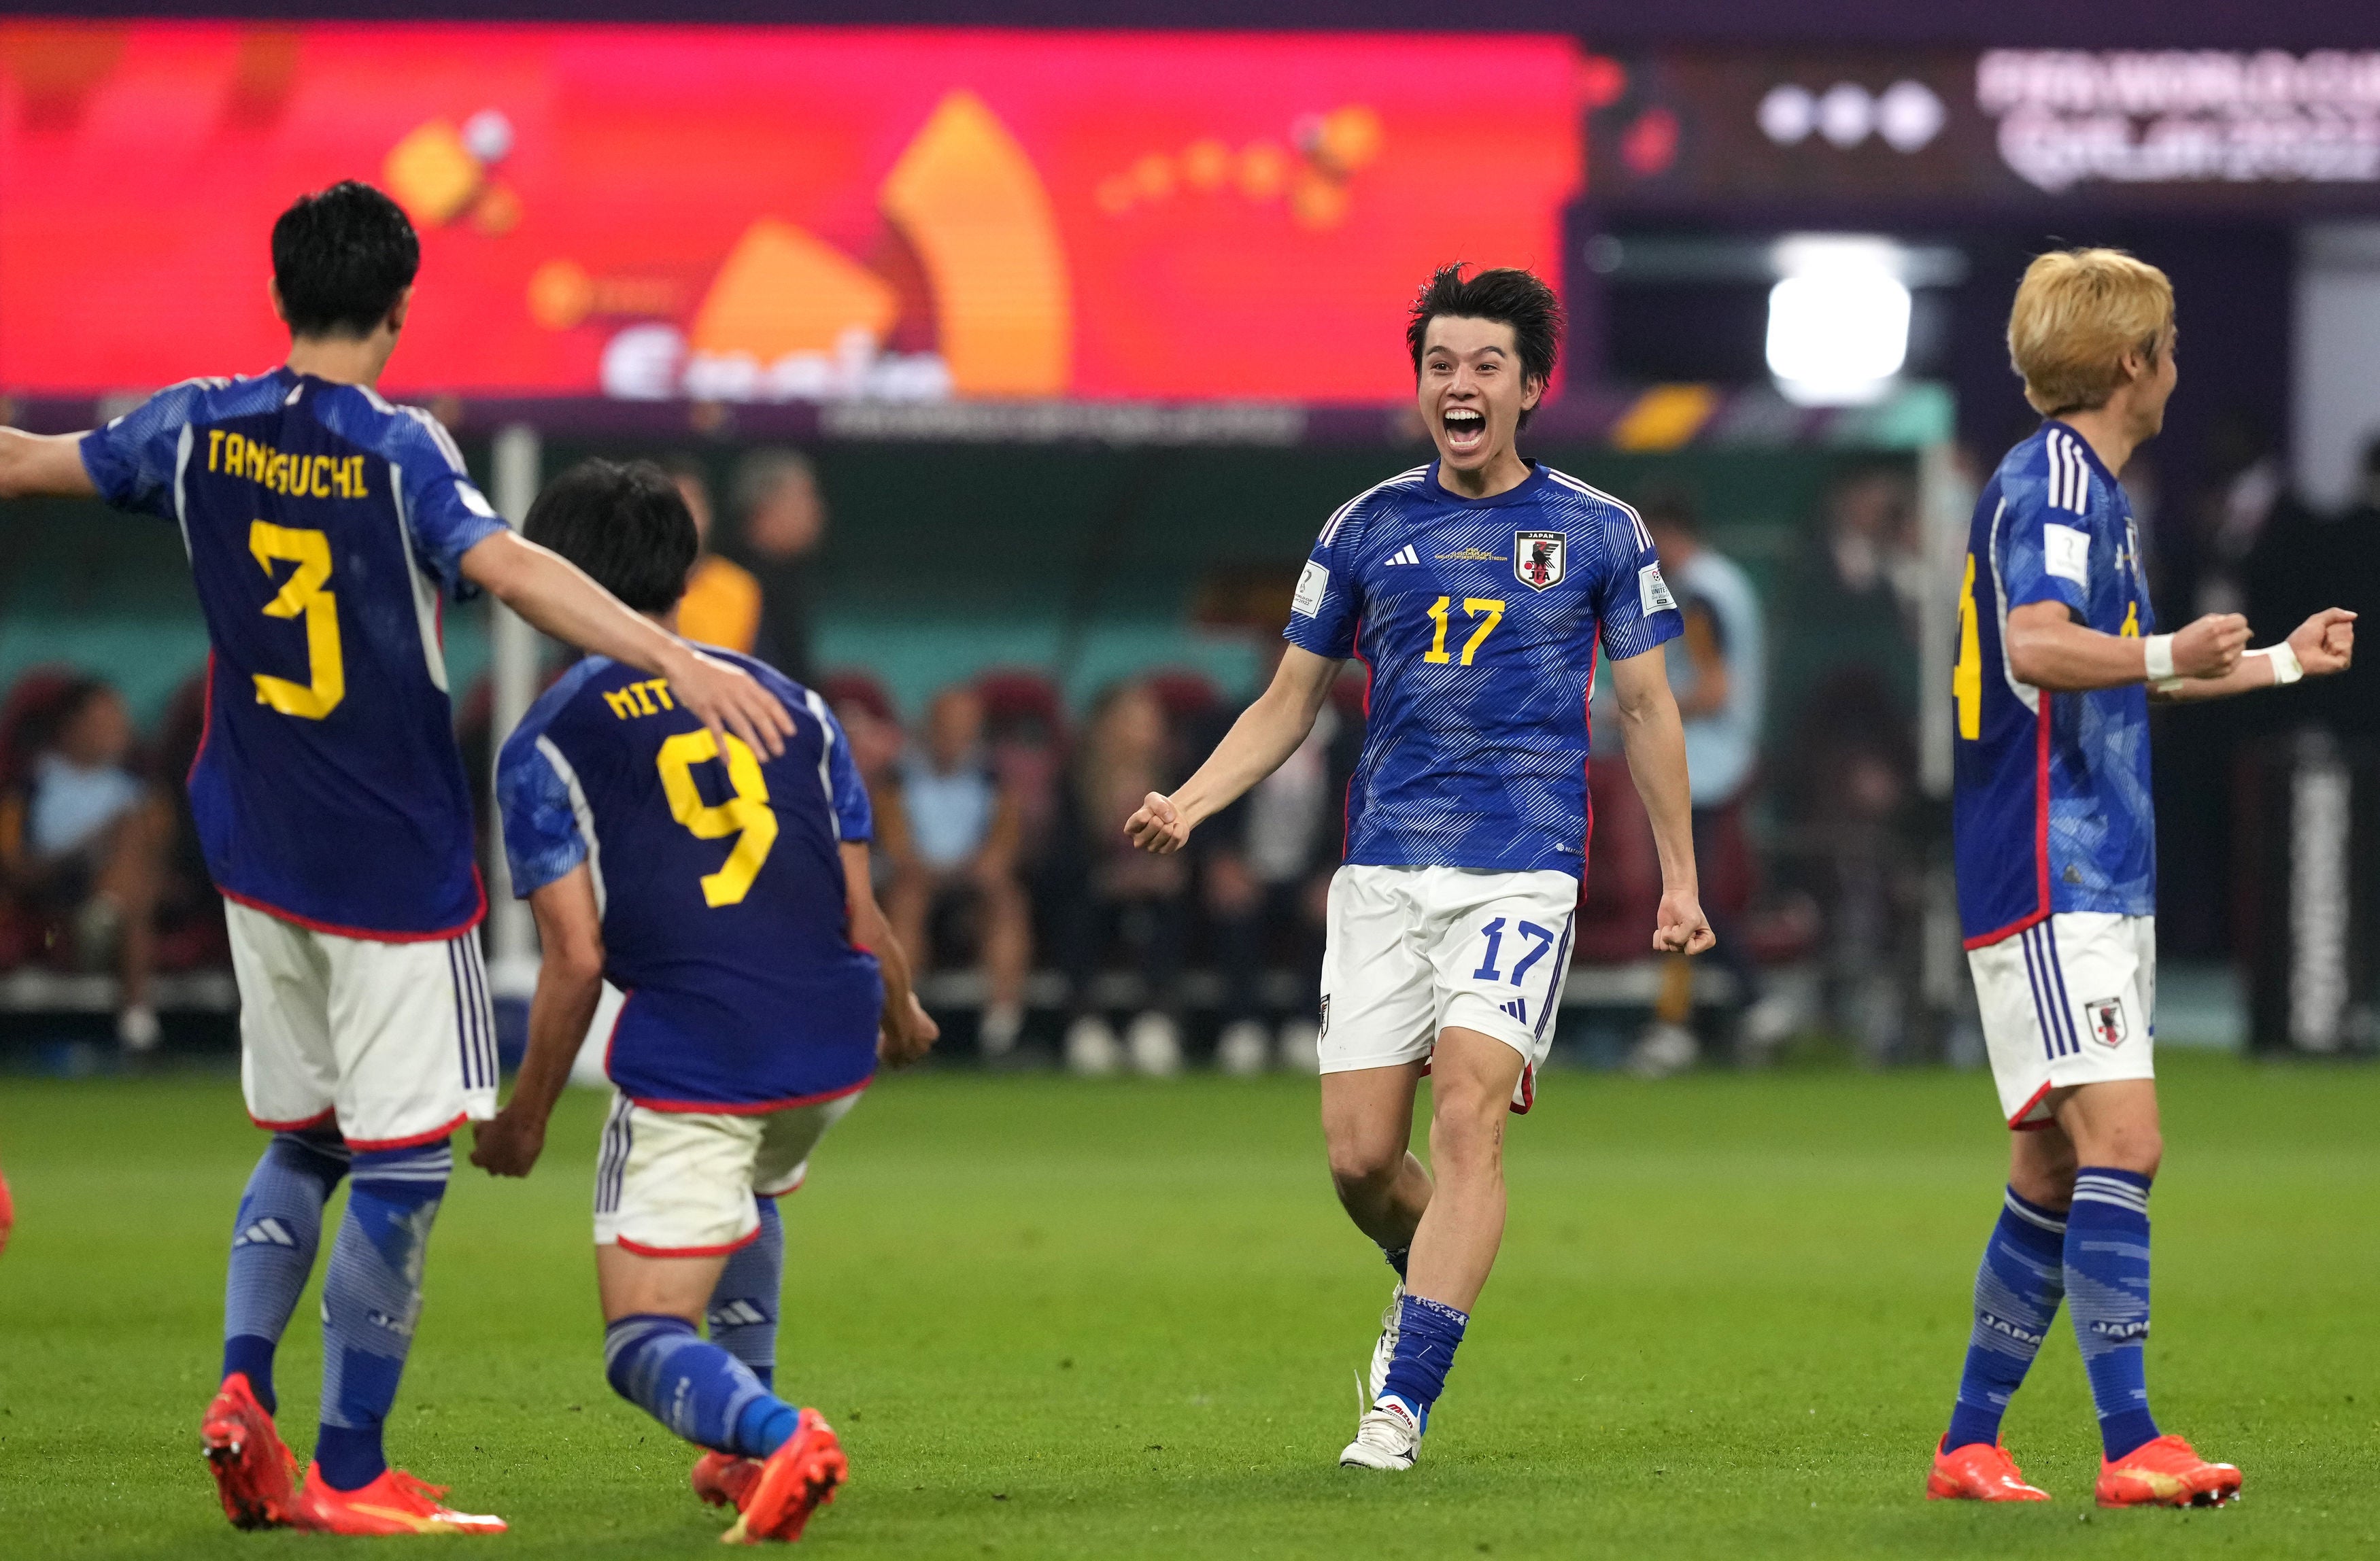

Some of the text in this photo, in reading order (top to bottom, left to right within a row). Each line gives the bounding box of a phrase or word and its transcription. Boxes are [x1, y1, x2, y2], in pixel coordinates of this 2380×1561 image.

[1529, 571, 1550, 581] JFA
[249, 519, 345, 720] 3
[1424, 596, 1506, 666] 17
[656, 726, 779, 908] 9
[1473, 917, 1554, 987] 17
